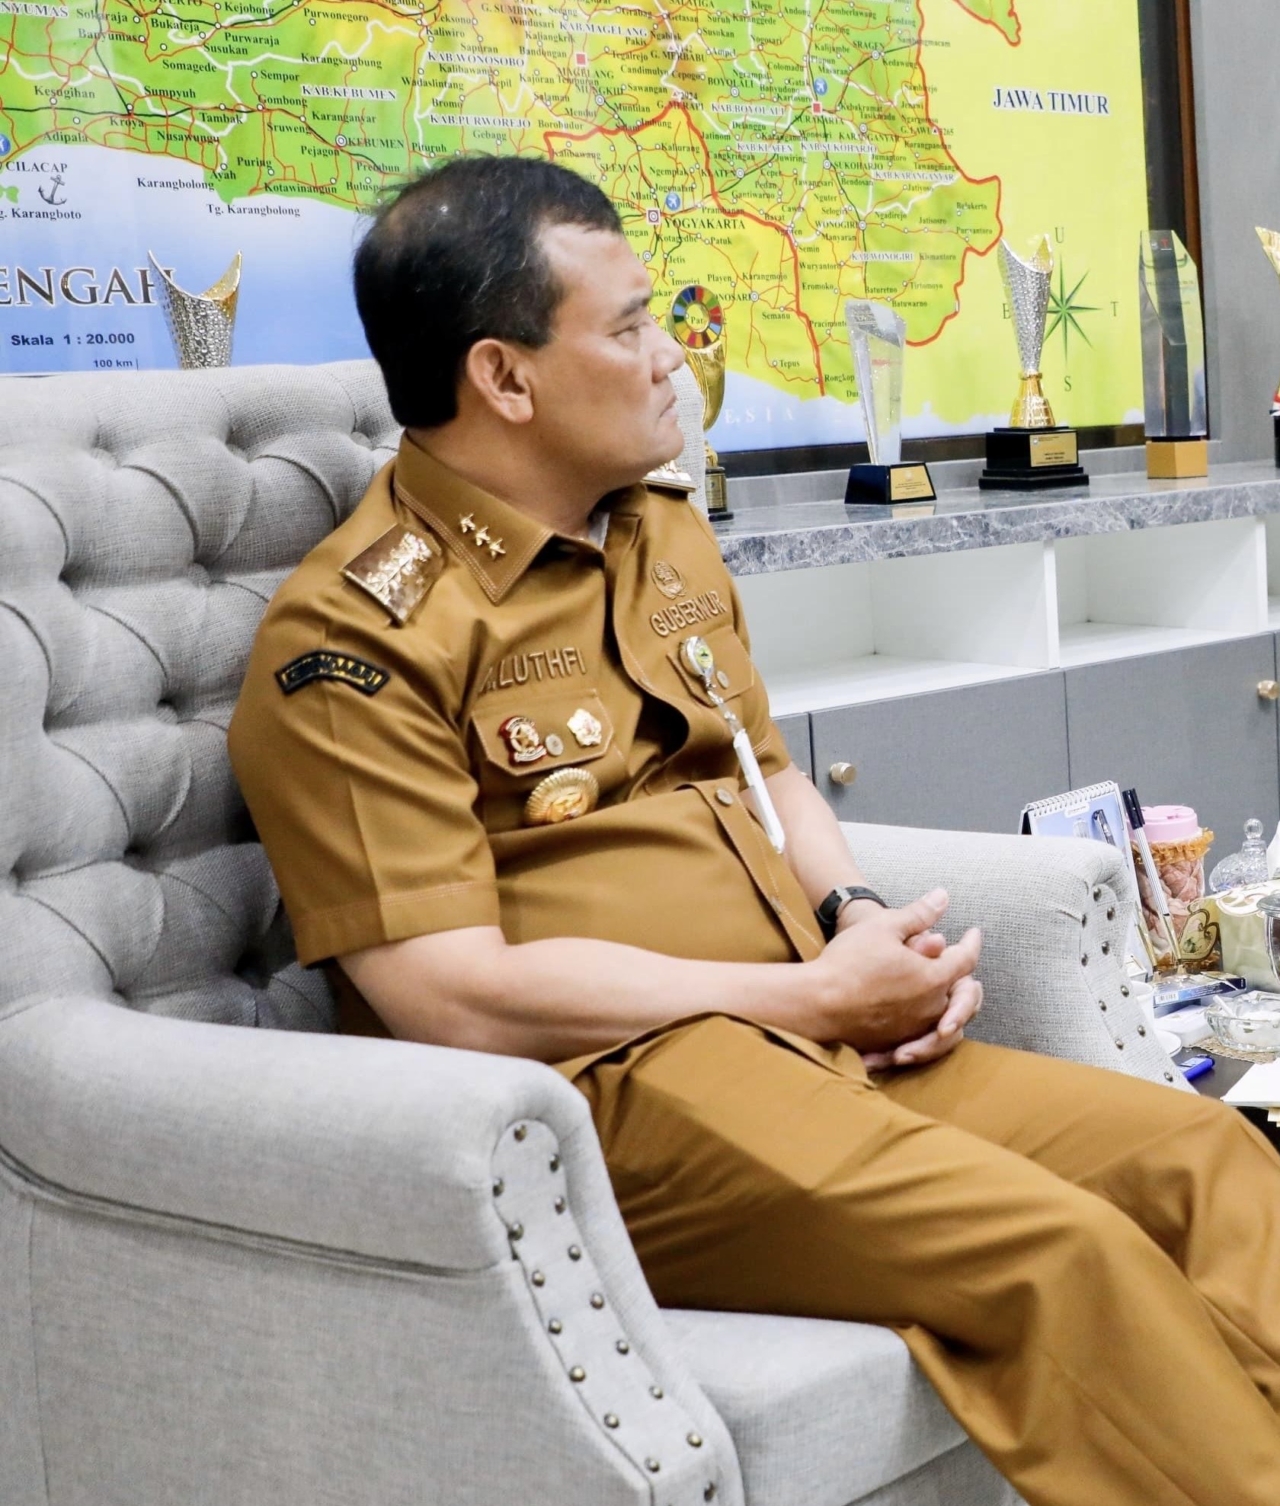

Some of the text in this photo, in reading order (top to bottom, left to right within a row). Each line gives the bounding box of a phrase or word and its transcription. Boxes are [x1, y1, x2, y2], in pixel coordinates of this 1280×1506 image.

[303, 8, 369, 23] Purwonegoro
[494, 4, 542, 16] SUMBING
[433, 13, 471, 24] Leksono
[509, 16, 555, 29] Windusari
[151, 18, 199, 33] Bukateja
[426, 26, 465, 38] Kaliwiro
[224, 32, 279, 46] Purwaraja
[625, 37, 647, 46] Pakis
[204, 43, 248, 55] Susukan
[460, 43, 499, 53] Sapuran
[162, 60, 217, 73] Somagede
[301, 53, 382, 69] Karangsambung
[260, 70, 299, 83] Sempor
[402, 76, 464, 90] Wadaslintang
[34, 85, 95, 100] Kesugihan
[144, 86, 196, 100] Sumpyuh
[627, 84, 667, 95] Sawangan
[258, 94, 308, 108] Gombong
[432, 97, 463, 108] Bromo
[993, 88, 1110, 115] JAWA TIMUR
[110, 117, 144, 129] Kroya
[200, 112, 243, 126] Tambak
[312, 111, 377, 125] Karanganyar
[267, 123, 311, 135] Sruweng
[43, 130, 88, 144] Adipala
[157, 130, 220, 144] Nusawungu
[348, 138, 404, 149] KEBUMEN
[301, 146, 340, 159] Pejagon
[412, 142, 447, 153] Pituruh
[6, 161, 68, 174] CILACAP
[237, 157, 272, 169] Puring
[834, 161, 883, 171] SUKOHARJO
[210, 170, 236, 182] Ayah
[137, 177, 214, 190] Karangbolong
[264, 183, 337, 195] Kotawinangun
[12, 207, 82, 220] Karangboto
[227, 205, 301, 217] Karangbolong
[664, 218, 746, 230] YOGYAKARTA
[710, 236, 732, 245] Patuk
[1055, 227, 1065, 244] U
[707, 274, 732, 284] Playen
[802, 282, 834, 291] Eromoko
[1110, 301, 1119, 317] T
[762, 312, 790, 320] Semanu
[11, 334, 54, 346] Skala
[63, 335, 70, 345] 1
[86, 333, 135, 345] 20.000
[93, 359, 133, 368] 100 km
[779, 359, 800, 368] Tepus
[1064, 375, 1072, 392] S
[650, 590, 728, 637] GUBERNUR
